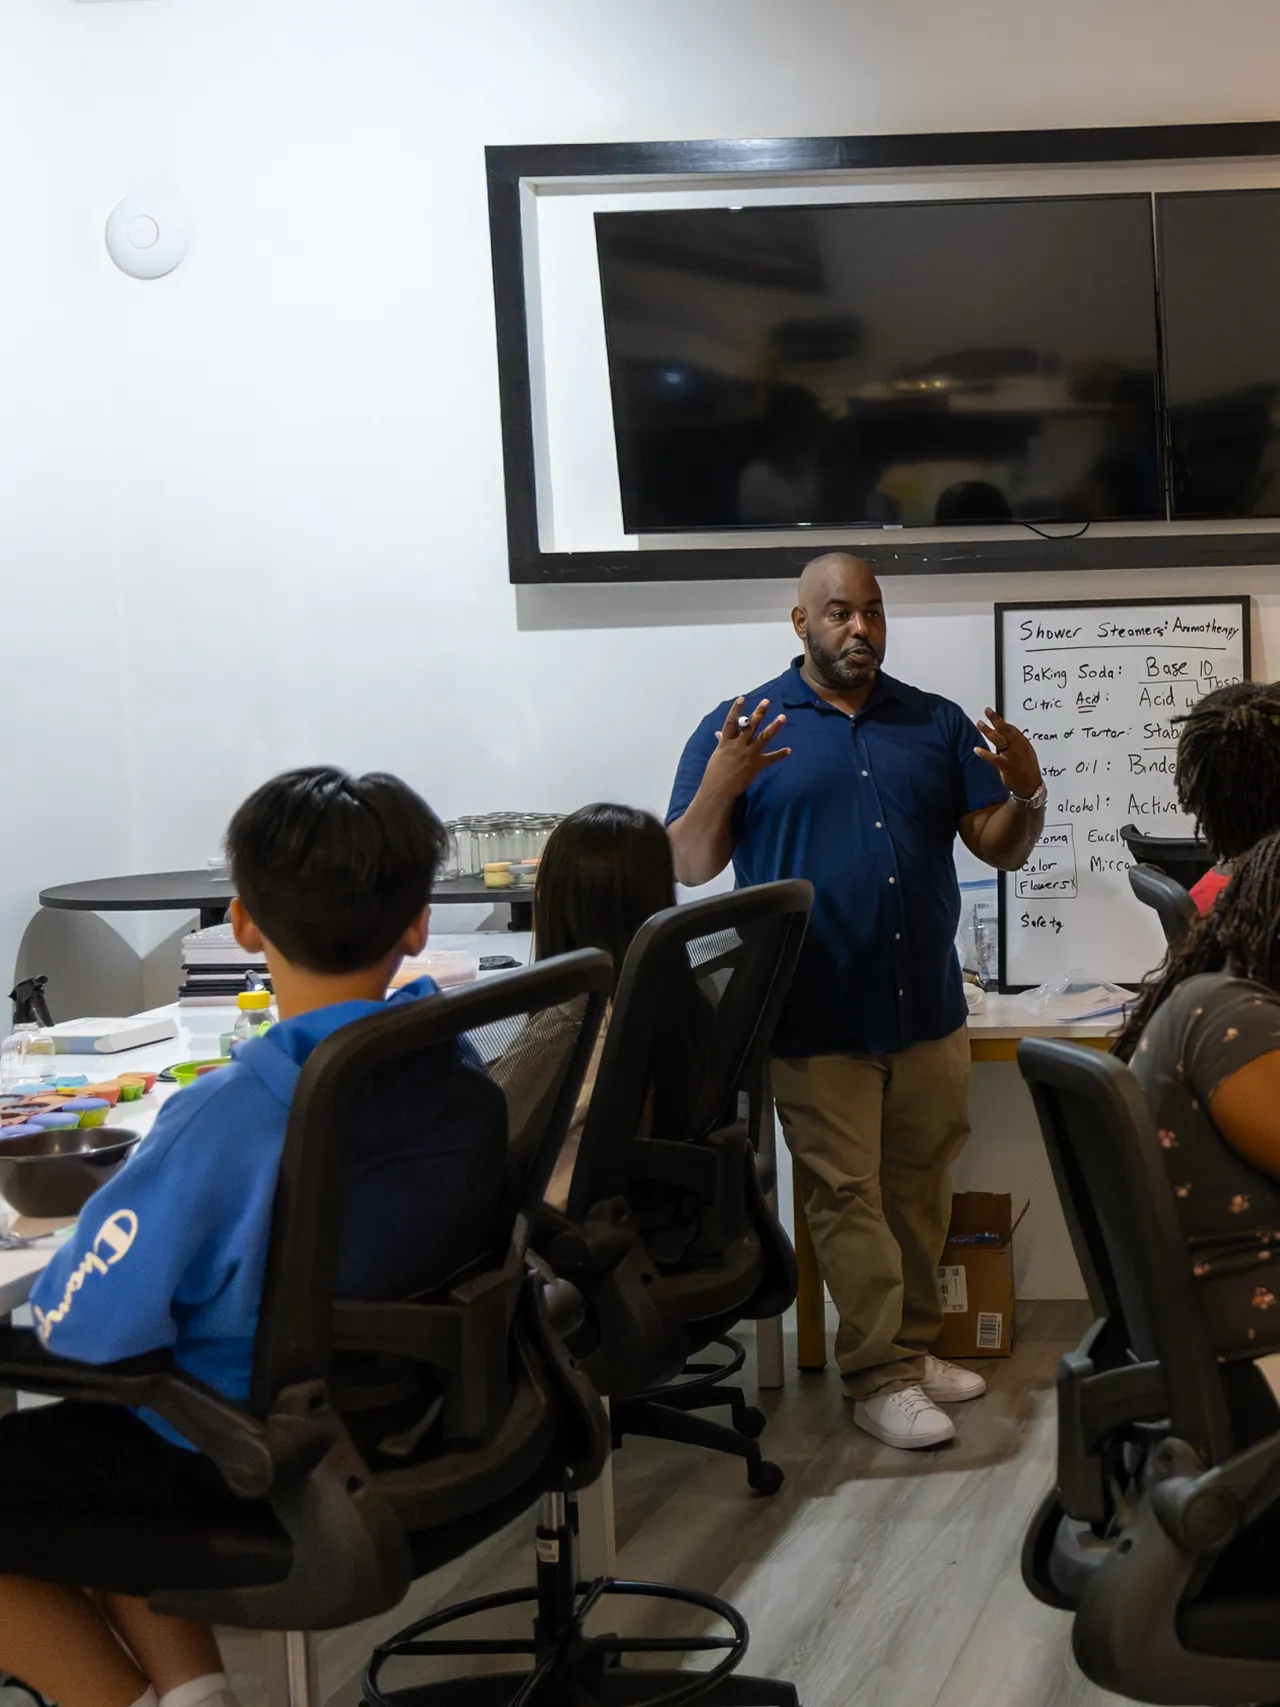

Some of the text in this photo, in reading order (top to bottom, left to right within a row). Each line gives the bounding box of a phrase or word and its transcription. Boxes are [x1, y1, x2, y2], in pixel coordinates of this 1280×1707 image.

[1020, 620, 1082, 641] Shower
[1022, 656, 1213, 689] Baking Soda: Base 10
[1022, 698, 1063, 712] Citric
[1139, 685, 1176, 708] Acid
[1063, 727, 1075, 740] of
[1036, 828, 1126, 848] roma Eucal
[1019, 879, 1070, 895] Flowers
[1020, 911, 1065, 934] Safety
